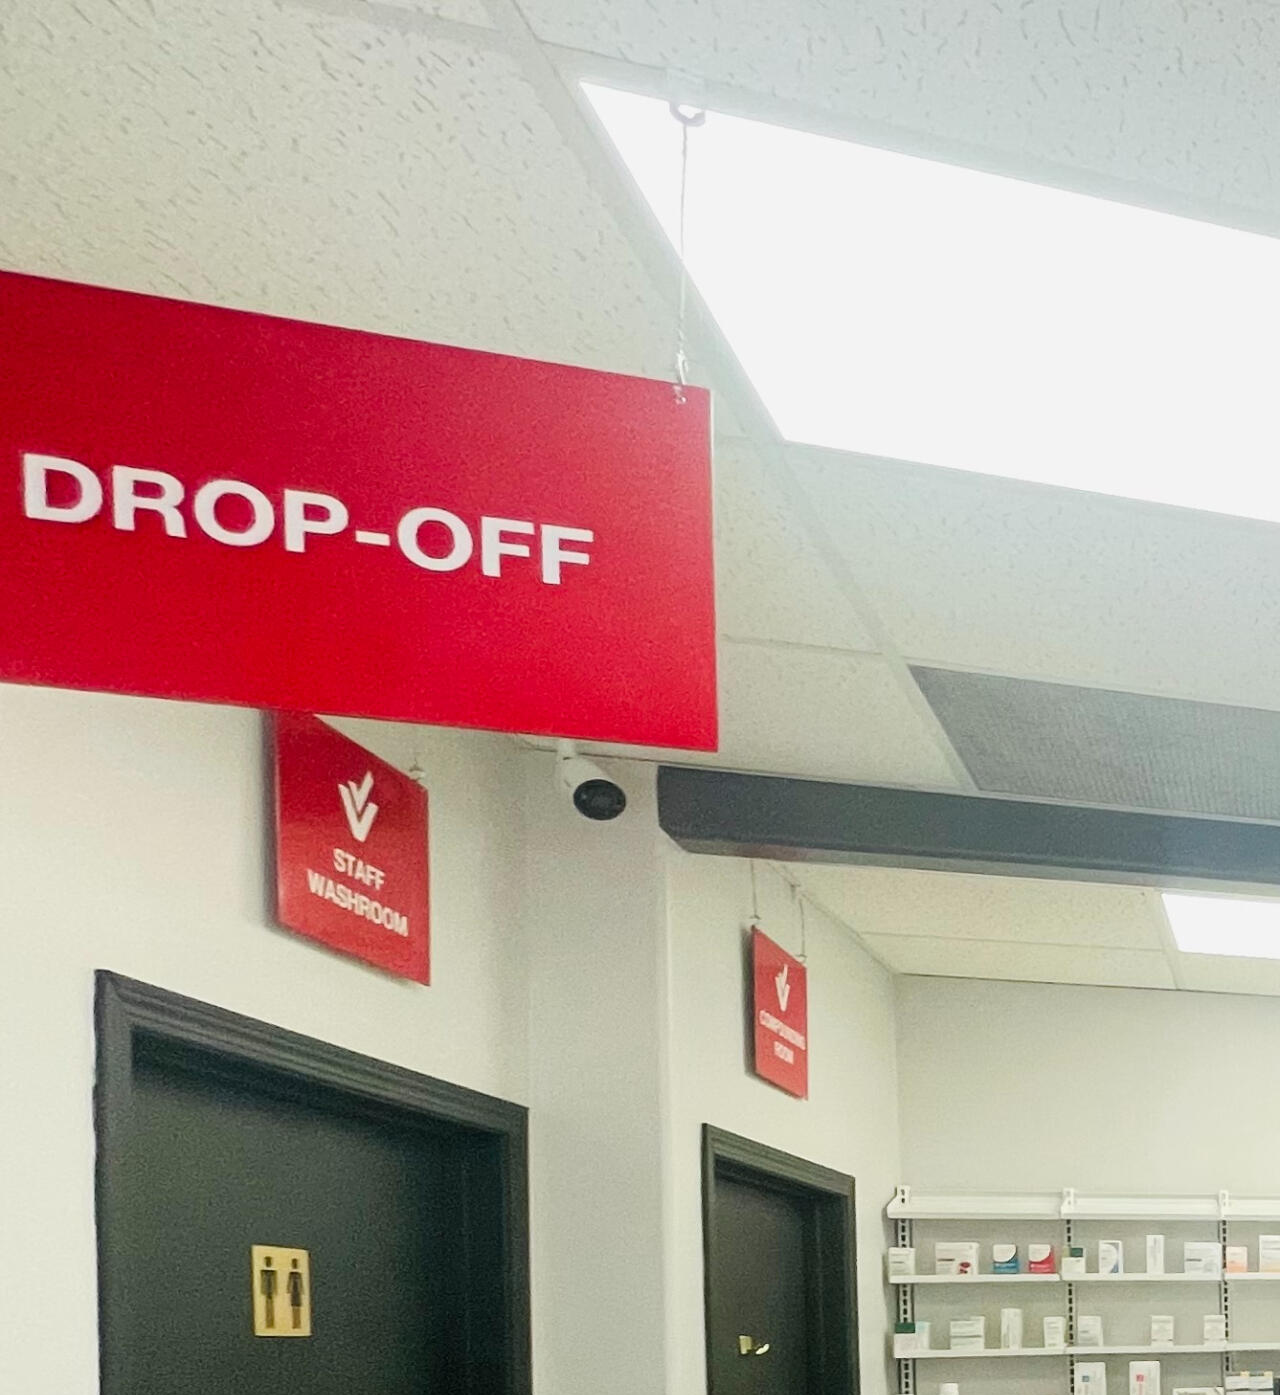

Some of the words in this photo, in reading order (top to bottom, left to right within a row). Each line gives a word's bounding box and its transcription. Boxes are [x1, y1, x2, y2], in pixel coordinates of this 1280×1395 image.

[21, 453, 596, 586] DROP-OFF
[307, 869, 409, 939] WASHROOM
[333, 848, 385, 891] STAFF
